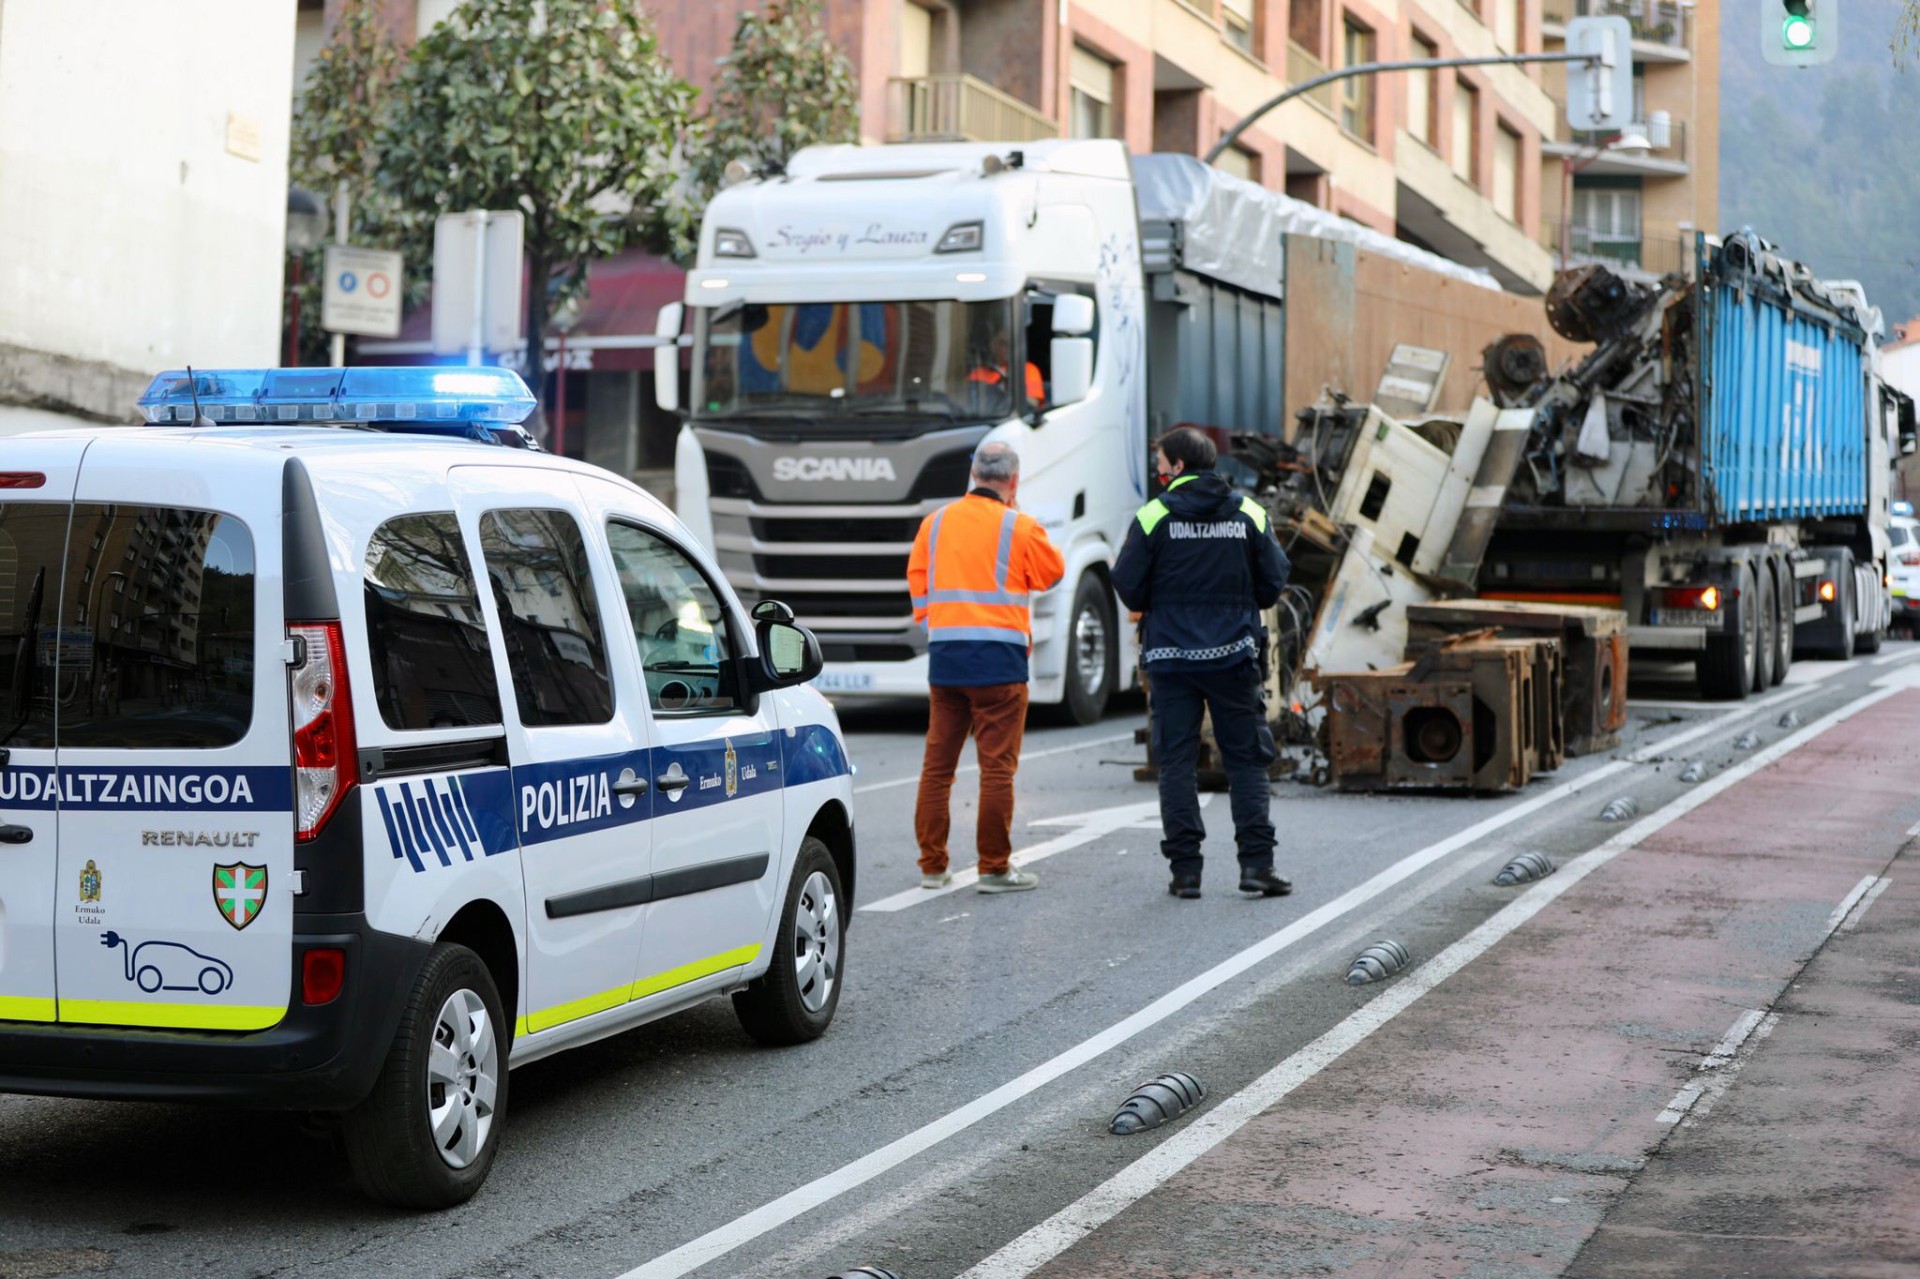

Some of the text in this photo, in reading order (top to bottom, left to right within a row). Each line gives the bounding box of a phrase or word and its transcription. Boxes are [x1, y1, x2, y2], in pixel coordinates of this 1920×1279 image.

[773, 457, 895, 481] SCANIA
[1169, 521, 1246, 539] UDALTZAINGOA
[0, 772, 254, 804] UDALTZAINGOA
[521, 772, 611, 832] POLIZIA
[142, 830, 260, 847] RENAULT
[75, 905, 106, 914] Ermuko
[78, 916, 101, 924] Udala
